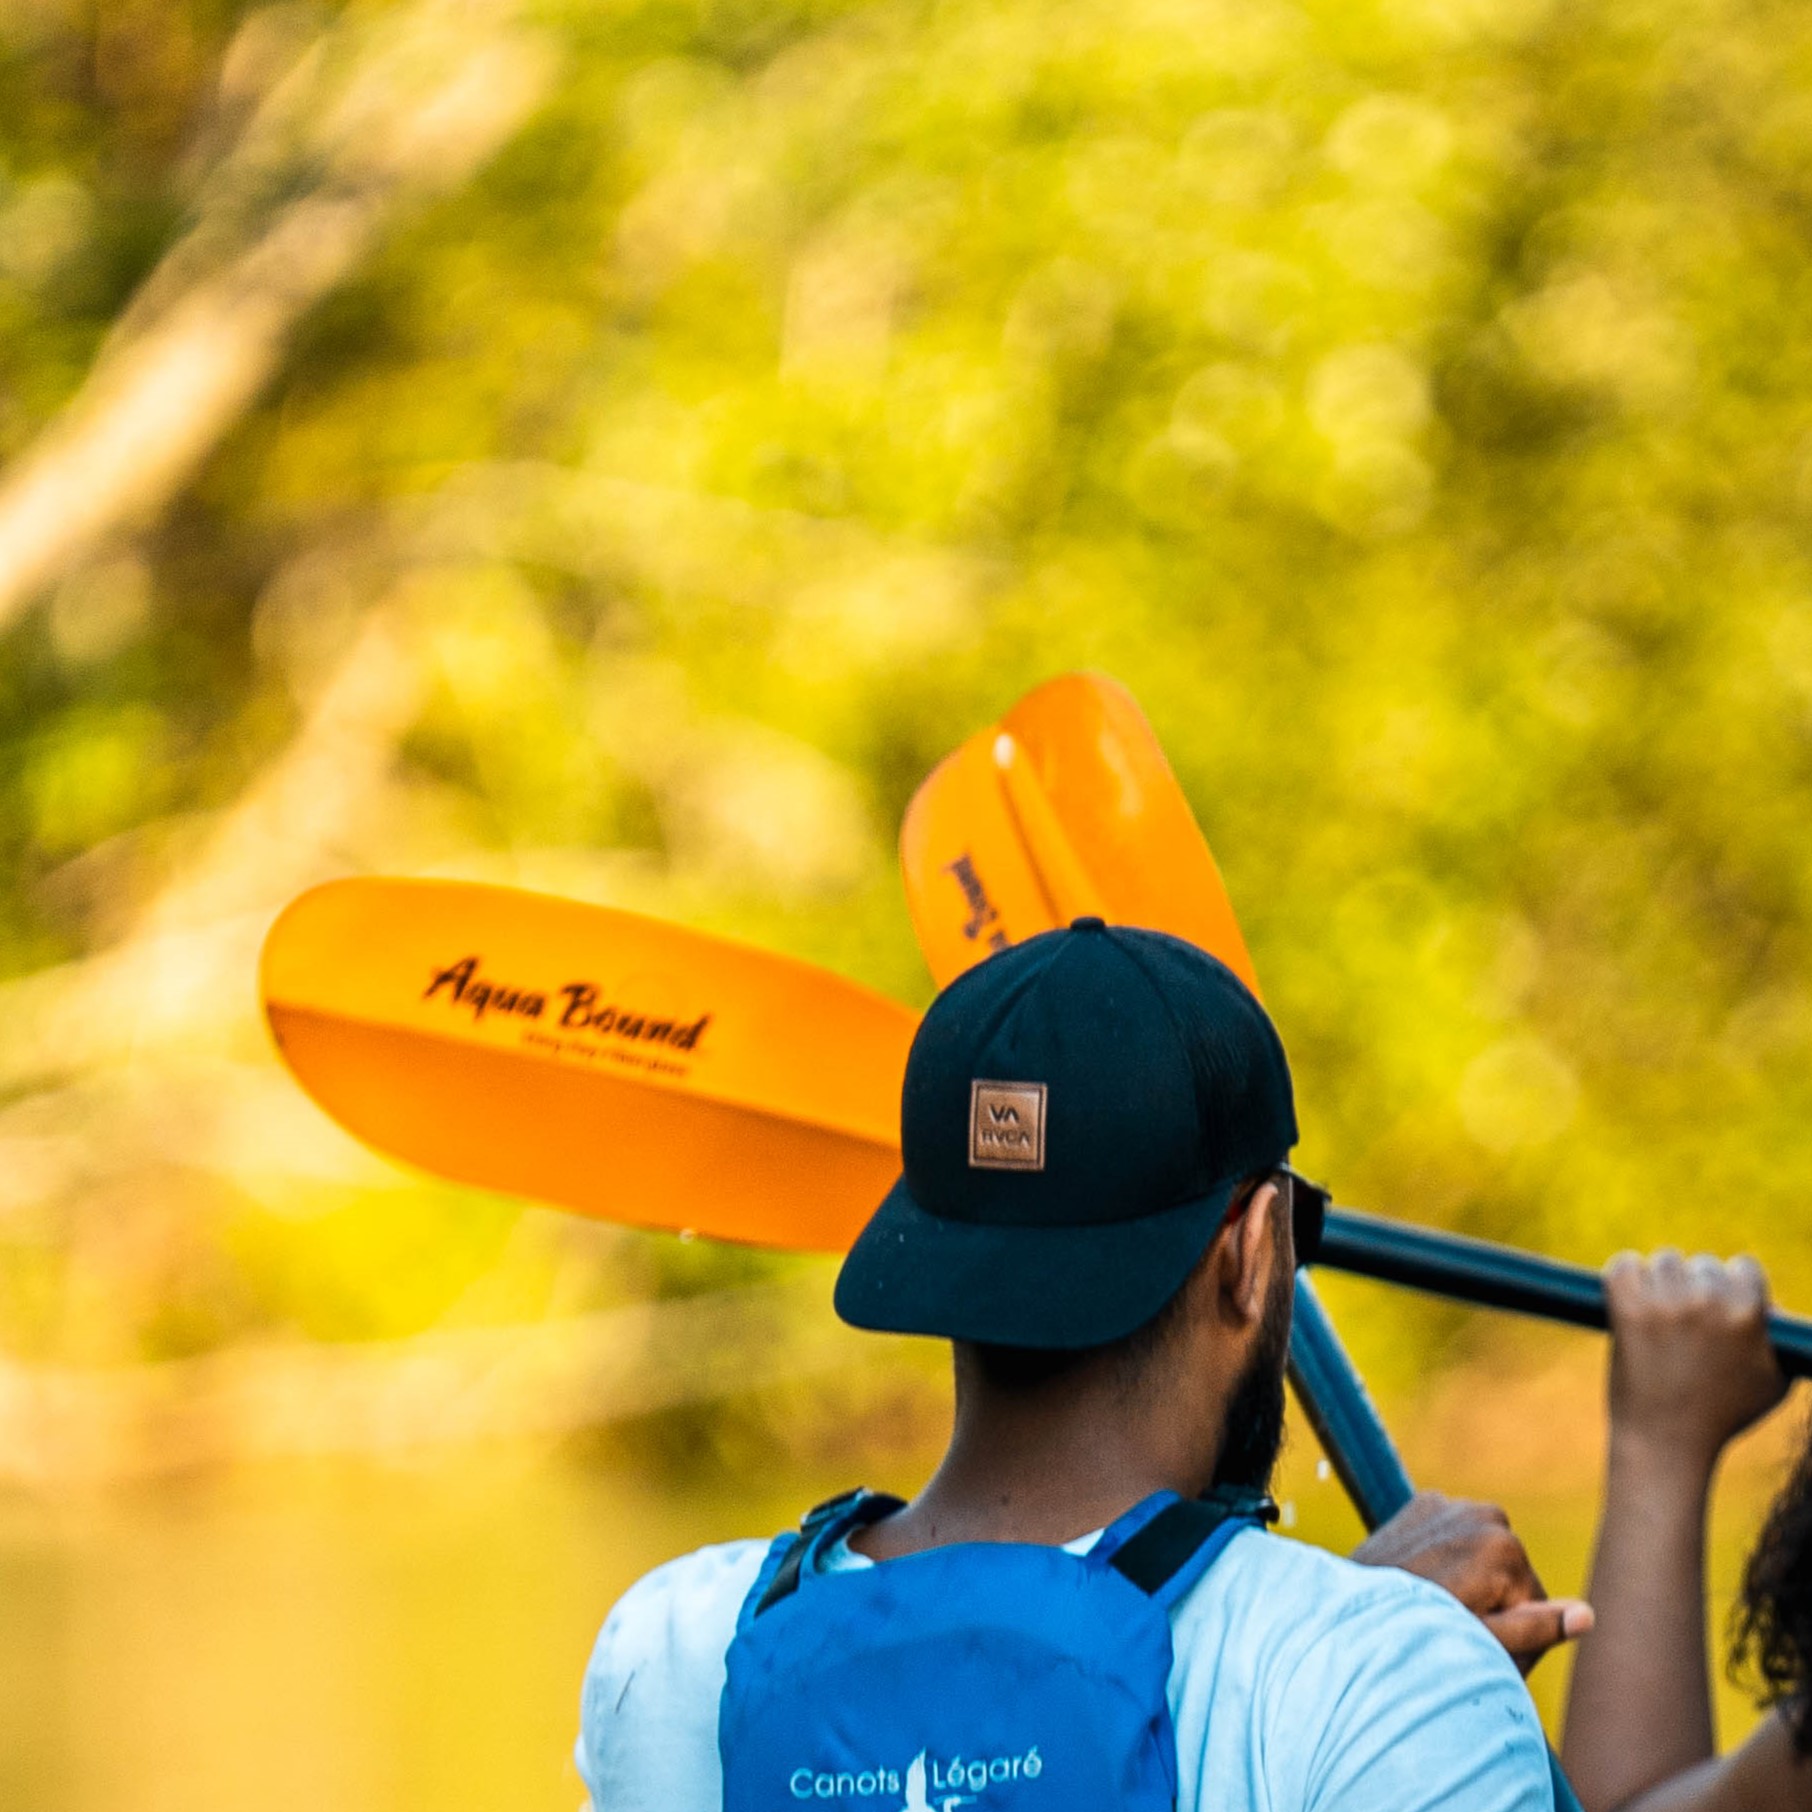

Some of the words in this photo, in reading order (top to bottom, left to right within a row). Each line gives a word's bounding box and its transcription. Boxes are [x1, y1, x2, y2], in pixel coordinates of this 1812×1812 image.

[423, 954, 547, 1022] Aqua
[560, 982, 712, 1052] Bound
[988, 1103, 1019, 1124] VA
[789, 1764, 900, 1799] Canots
[932, 1745, 1043, 1793] Légaré
